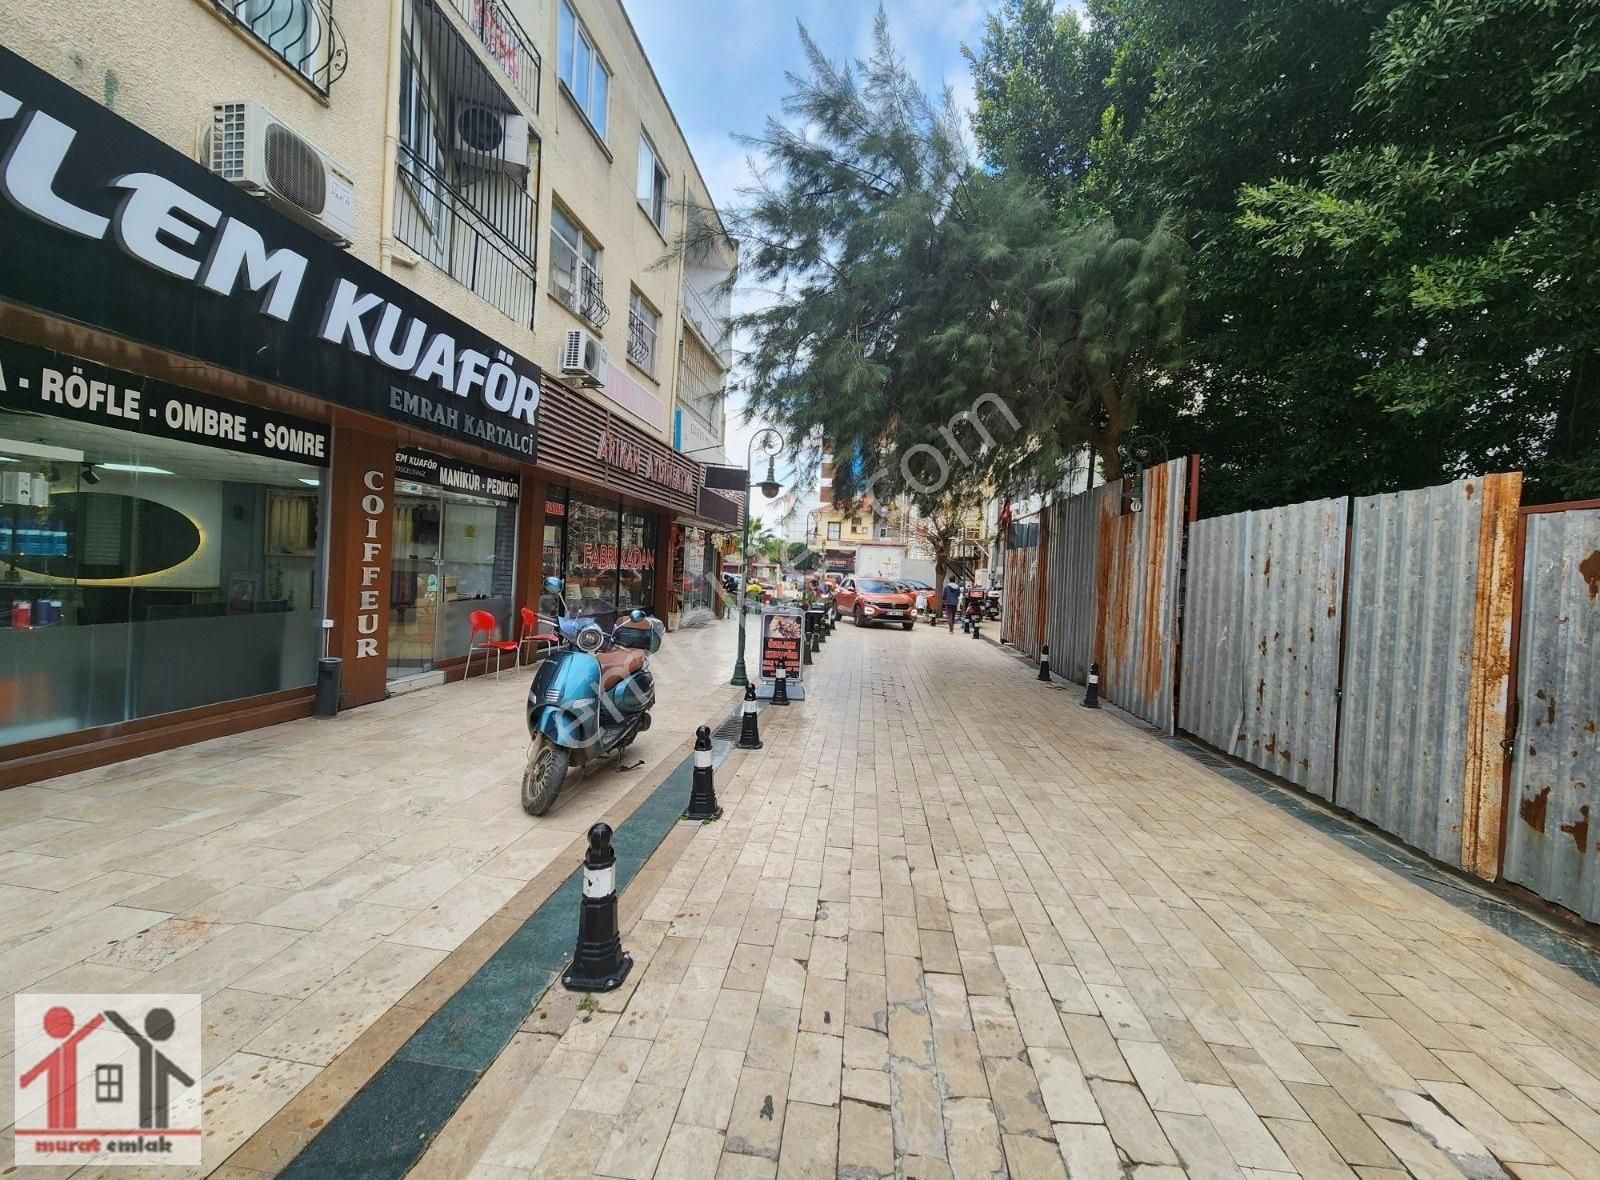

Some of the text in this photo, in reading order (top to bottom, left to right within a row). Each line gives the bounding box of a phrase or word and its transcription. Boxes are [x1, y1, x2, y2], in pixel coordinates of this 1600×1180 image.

[0, 89, 540, 426] LEM KUAFÖR
[41, 366, 141, 421] RÖFLE
[165, 399, 247, 442] OMBRE
[264, 422, 325, 458] SOMRE
[389, 385, 459, 430] EMRAH
[439, 465, 481, 492] MANİKÜR
[355, 470, 385, 659] COIFFEUR
